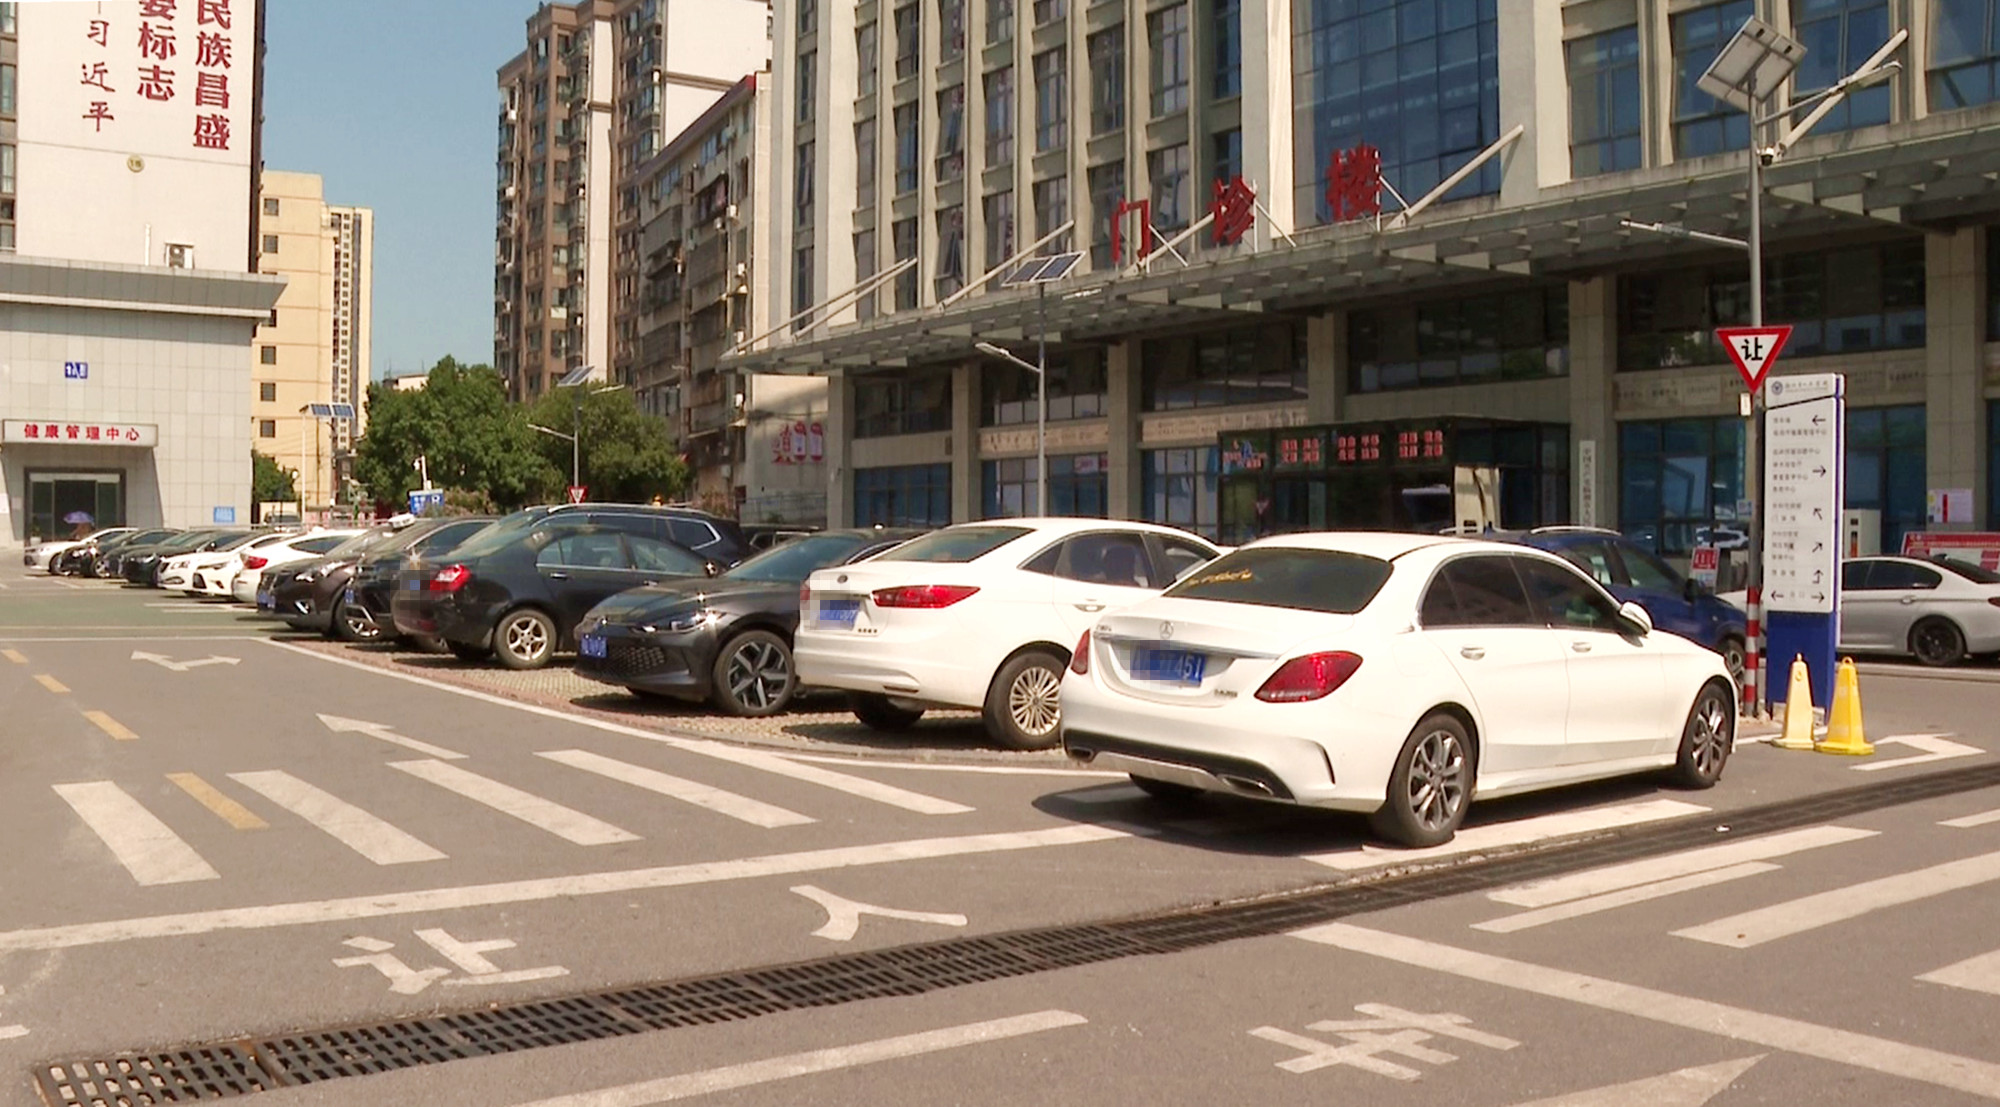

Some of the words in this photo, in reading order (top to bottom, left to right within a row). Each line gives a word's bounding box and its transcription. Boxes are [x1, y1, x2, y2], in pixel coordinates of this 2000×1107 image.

[1109, 142, 1383, 264] 门诊楼
[1741, 336, 1763, 361] 让
[24, 423, 140, 441] 健康管理中心
